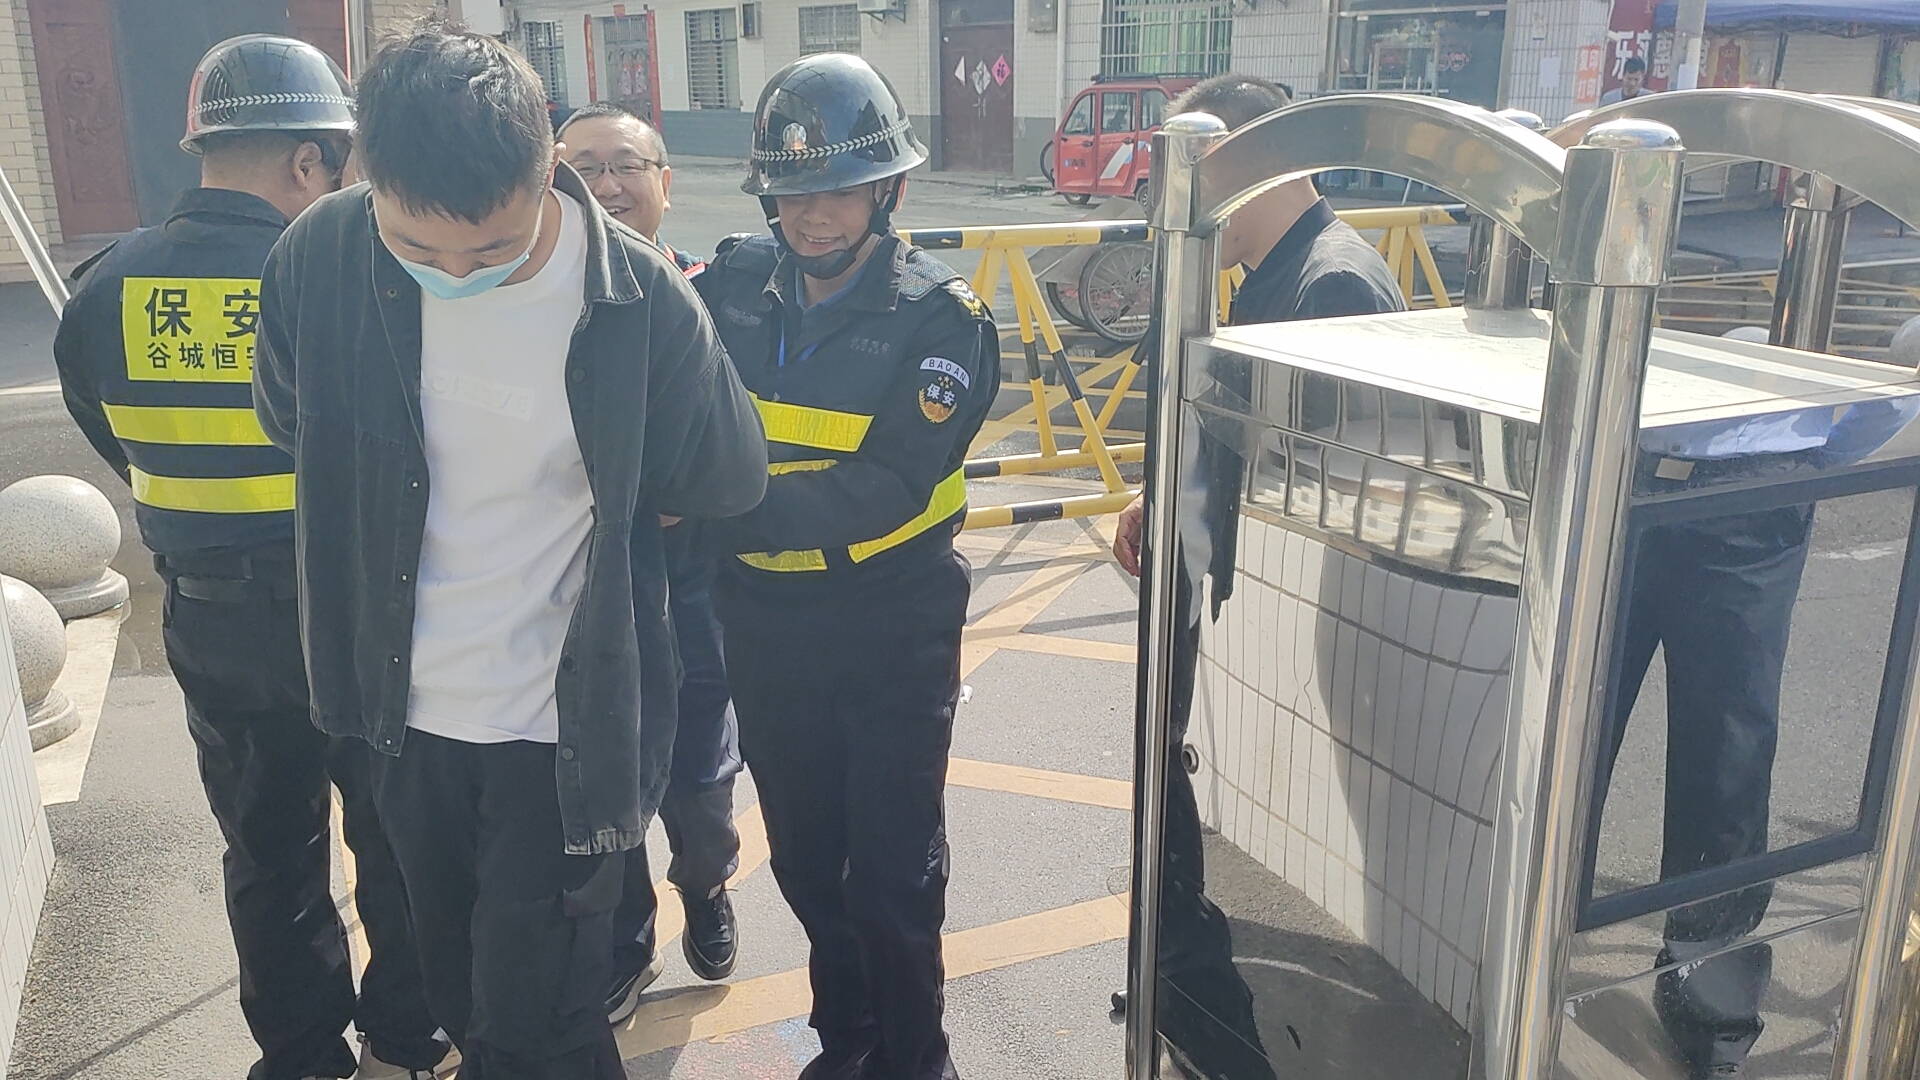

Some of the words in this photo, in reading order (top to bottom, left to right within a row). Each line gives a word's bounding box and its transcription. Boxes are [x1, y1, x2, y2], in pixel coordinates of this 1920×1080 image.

[144, 286, 259, 338] 保安
[928, 359, 967, 382] BAOAN
[927, 383, 955, 407] 保安
